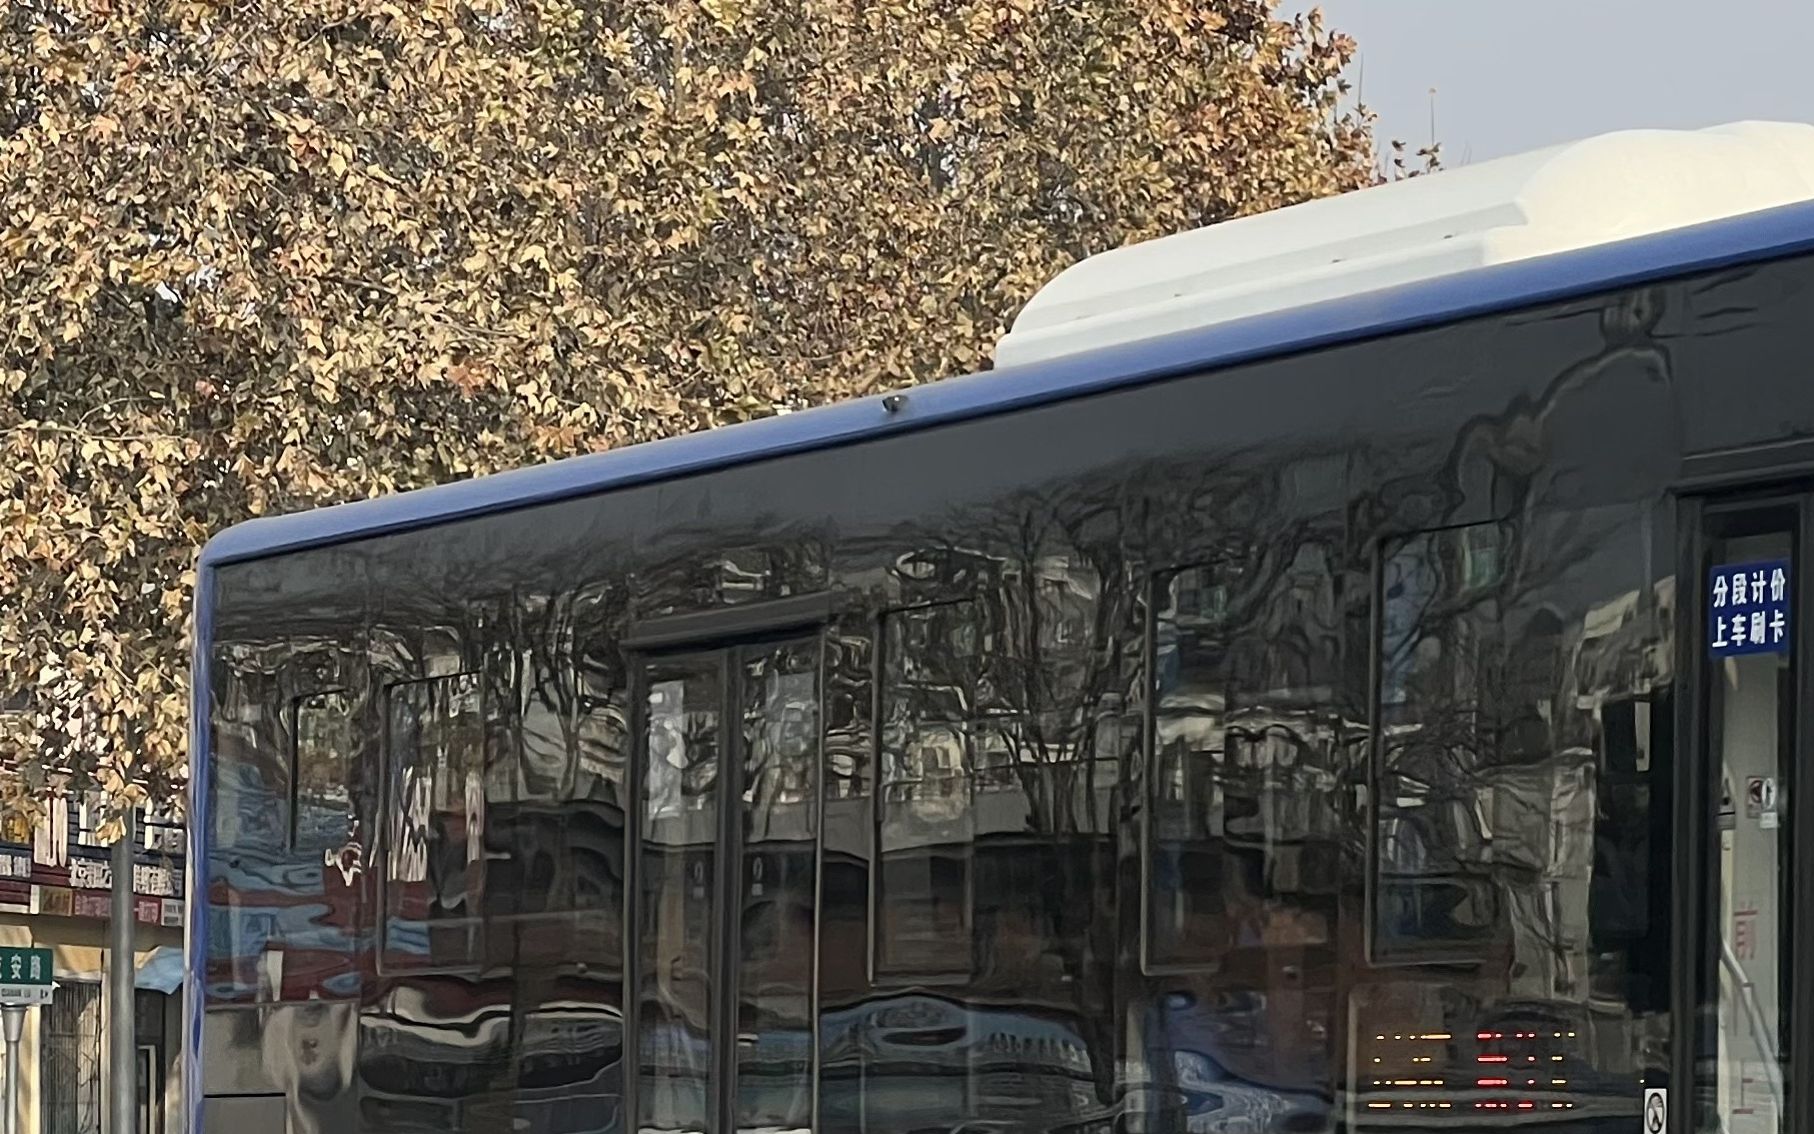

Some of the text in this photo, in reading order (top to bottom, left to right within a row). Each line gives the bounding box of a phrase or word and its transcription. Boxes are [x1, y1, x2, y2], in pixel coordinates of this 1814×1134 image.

[1712, 568, 1786, 608] 分段计价
[1711, 610, 1786, 648] 上车刷卡
